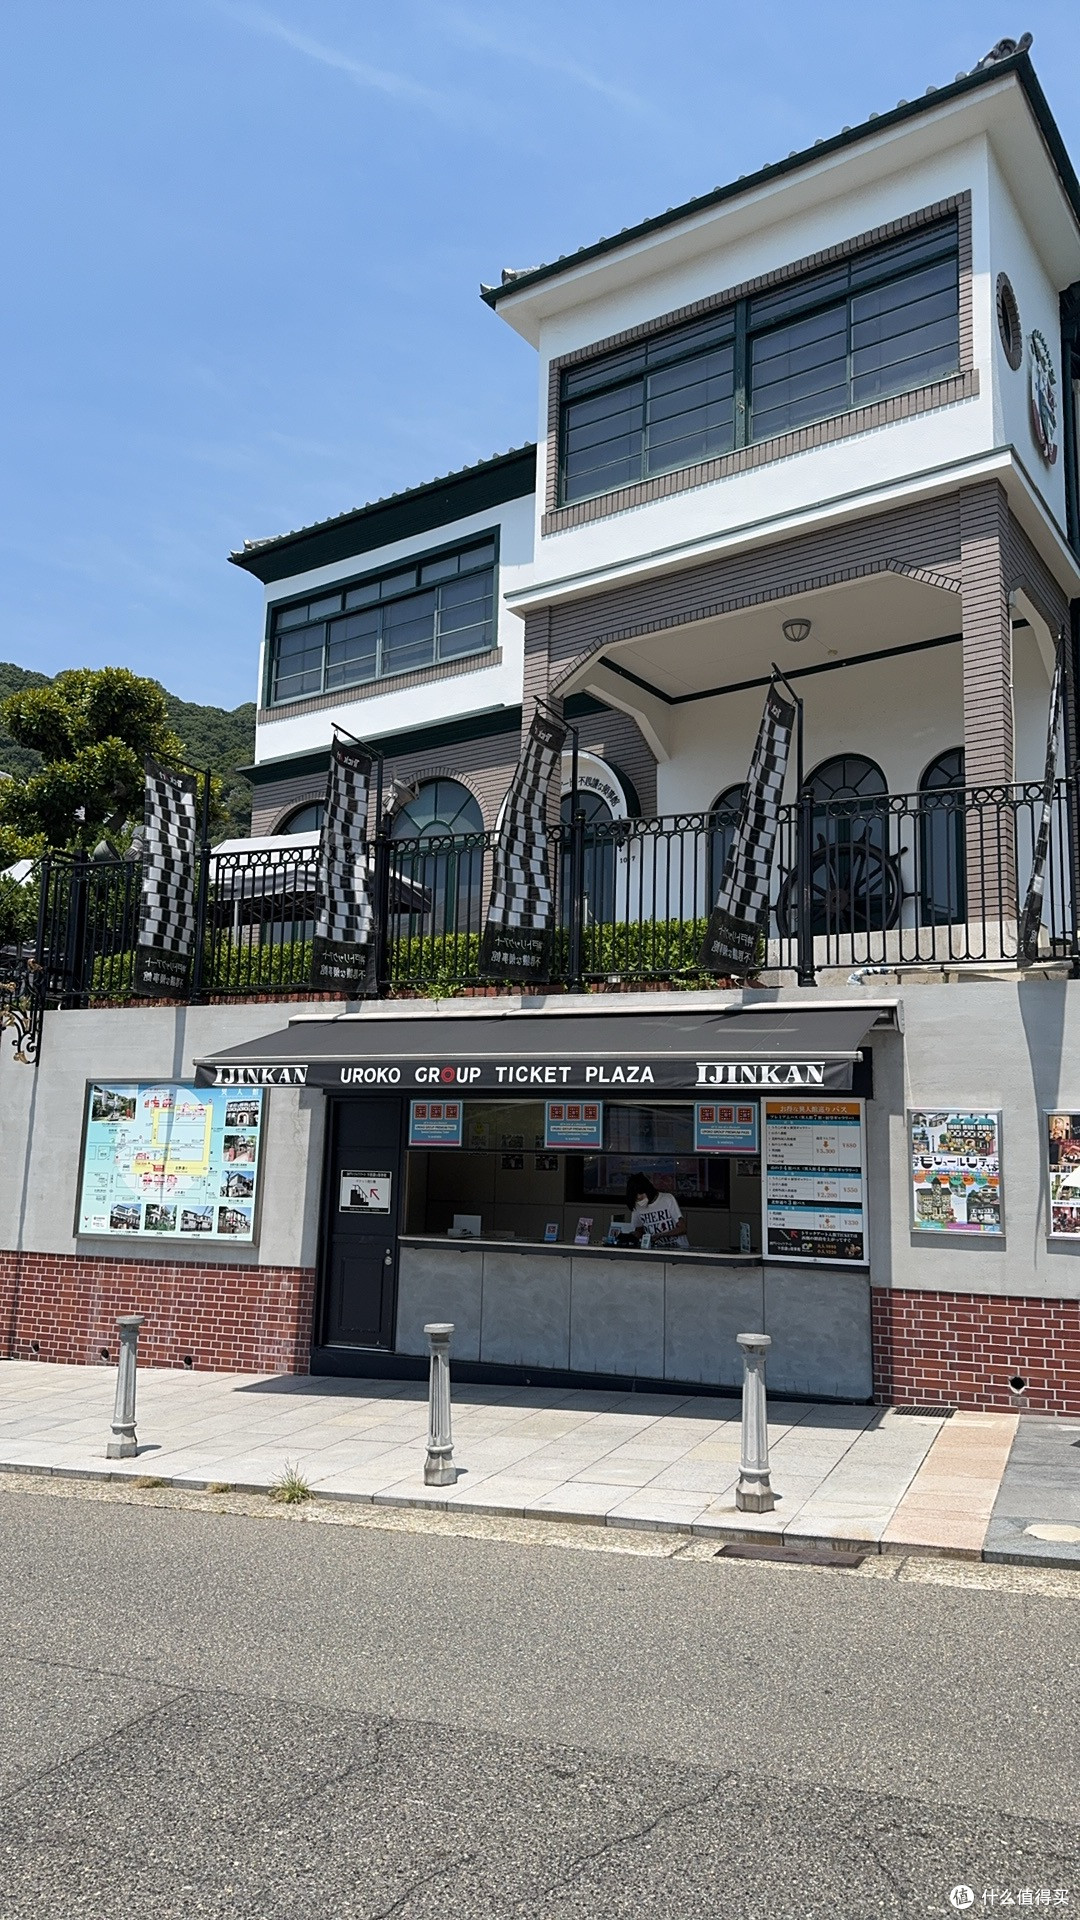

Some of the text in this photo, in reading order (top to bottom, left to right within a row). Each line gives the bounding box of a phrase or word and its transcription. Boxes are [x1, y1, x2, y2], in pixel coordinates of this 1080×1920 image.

[214, 1067, 308, 1084] IJINKAN
[340, 1066, 655, 1083] UROKO GROUP TICKET PLAZA
[696, 1065, 825, 1084] IJINKAN
[640, 1209, 672, 1224] SHERL
